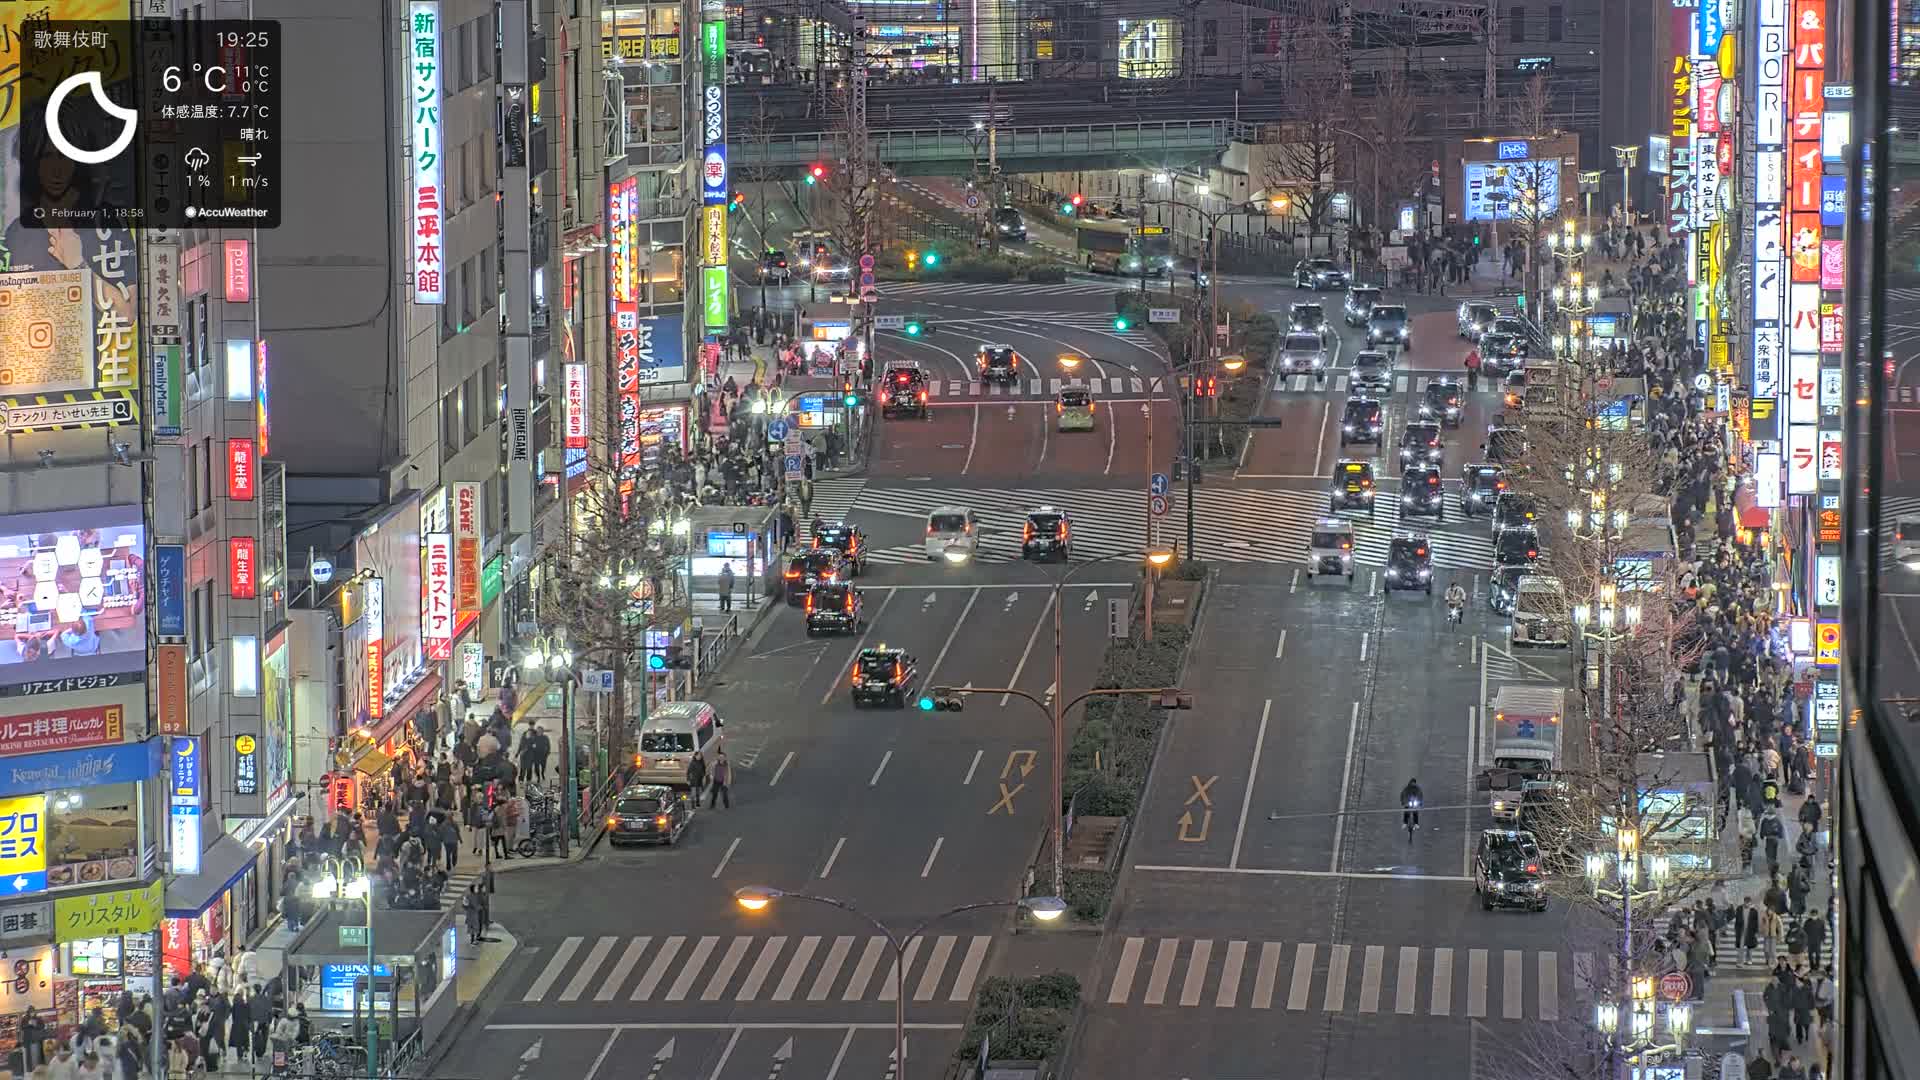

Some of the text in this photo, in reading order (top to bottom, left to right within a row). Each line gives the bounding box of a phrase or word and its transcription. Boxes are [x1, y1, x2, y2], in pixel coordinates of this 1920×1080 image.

[1673, 55, 1691, 136] パチンコ
[1703, 88, 1716, 120] アコム
[414, 13, 440, 293] 新宿サンパーク 三平本館
[1671, 147, 1692, 233] エスパス
[156, 326, 174, 335] 3F
[619, 332, 637, 389] ラーメン
[1757, 331, 1771, 383] 大衆酒場
[156, 355, 168, 416] FamilyMart
[1792, 309, 1818, 470] パセラ
[11, 406, 111, 423] テンクリ たいせい先生
[1825, 406, 1839, 416] 5F
[513, 408, 527, 461] HOMEGAME
[234, 451, 248, 489] 龍生堂
[1825, 498, 1837, 507] 3F
[236, 548, 249, 584] 龍生堂
[431, 544, 448, 630] 三平ストア
[0, 717, 69, 740] ルコ料理
[164, 722, 180, 732] B2
[0, 813, 38, 836] プロ
[179, 806, 193, 815] 2F
[0, 836, 39, 859] ミス
[3, 913, 37, 933] 囲碁
[68, 903, 141, 928] クリスタル
